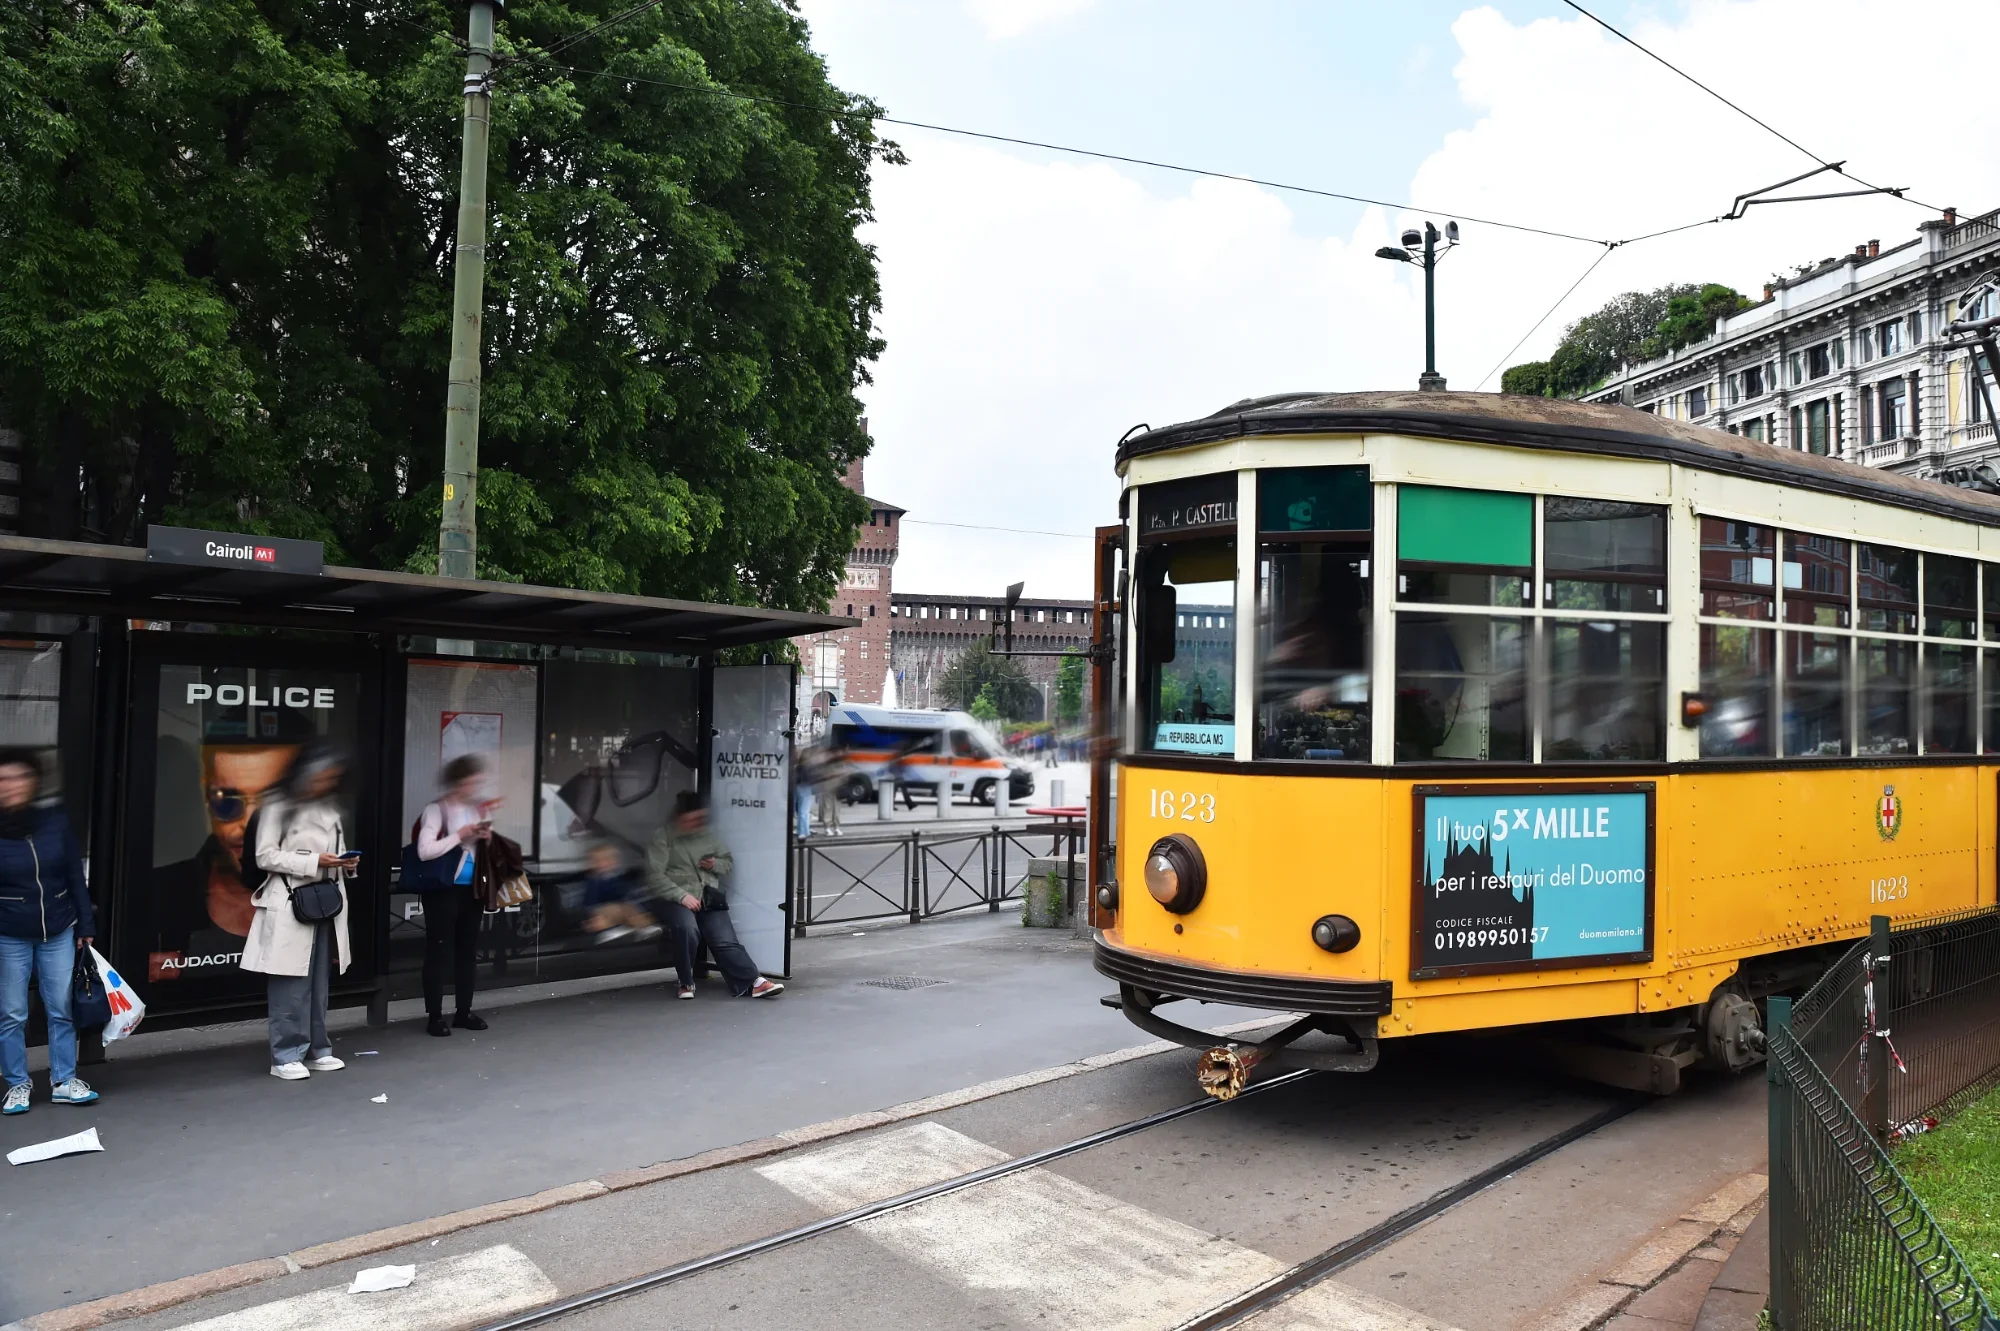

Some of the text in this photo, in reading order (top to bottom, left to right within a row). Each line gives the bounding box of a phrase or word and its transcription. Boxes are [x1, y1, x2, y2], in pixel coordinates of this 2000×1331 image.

[206, 541, 273, 560] Cairoli M1
[186, 683, 335, 708] POLICE
[1169, 732, 1212, 745] REPUBBLICA
[1213, 734, 1224, 745] M3
[716, 752, 784, 766] AUDACITY
[719, 766, 781, 780] WANTED.
[731, 798, 766, 809] POLICE
[1151, 788, 1216, 824] 1623
[1437, 816, 1448, 841] Il
[1454, 820, 1486, 841] tuo
[1435, 863, 1645, 899] per i restauri del Duomo
[1870, 875, 1908, 904] 1623
[1435, 915, 1513, 929] CODICE FISCALE
[1434, 926, 1549, 950] 01989950157
[1578, 926, 1644, 940] duomomilano.it
[161, 952, 243, 970] AUDACIT
